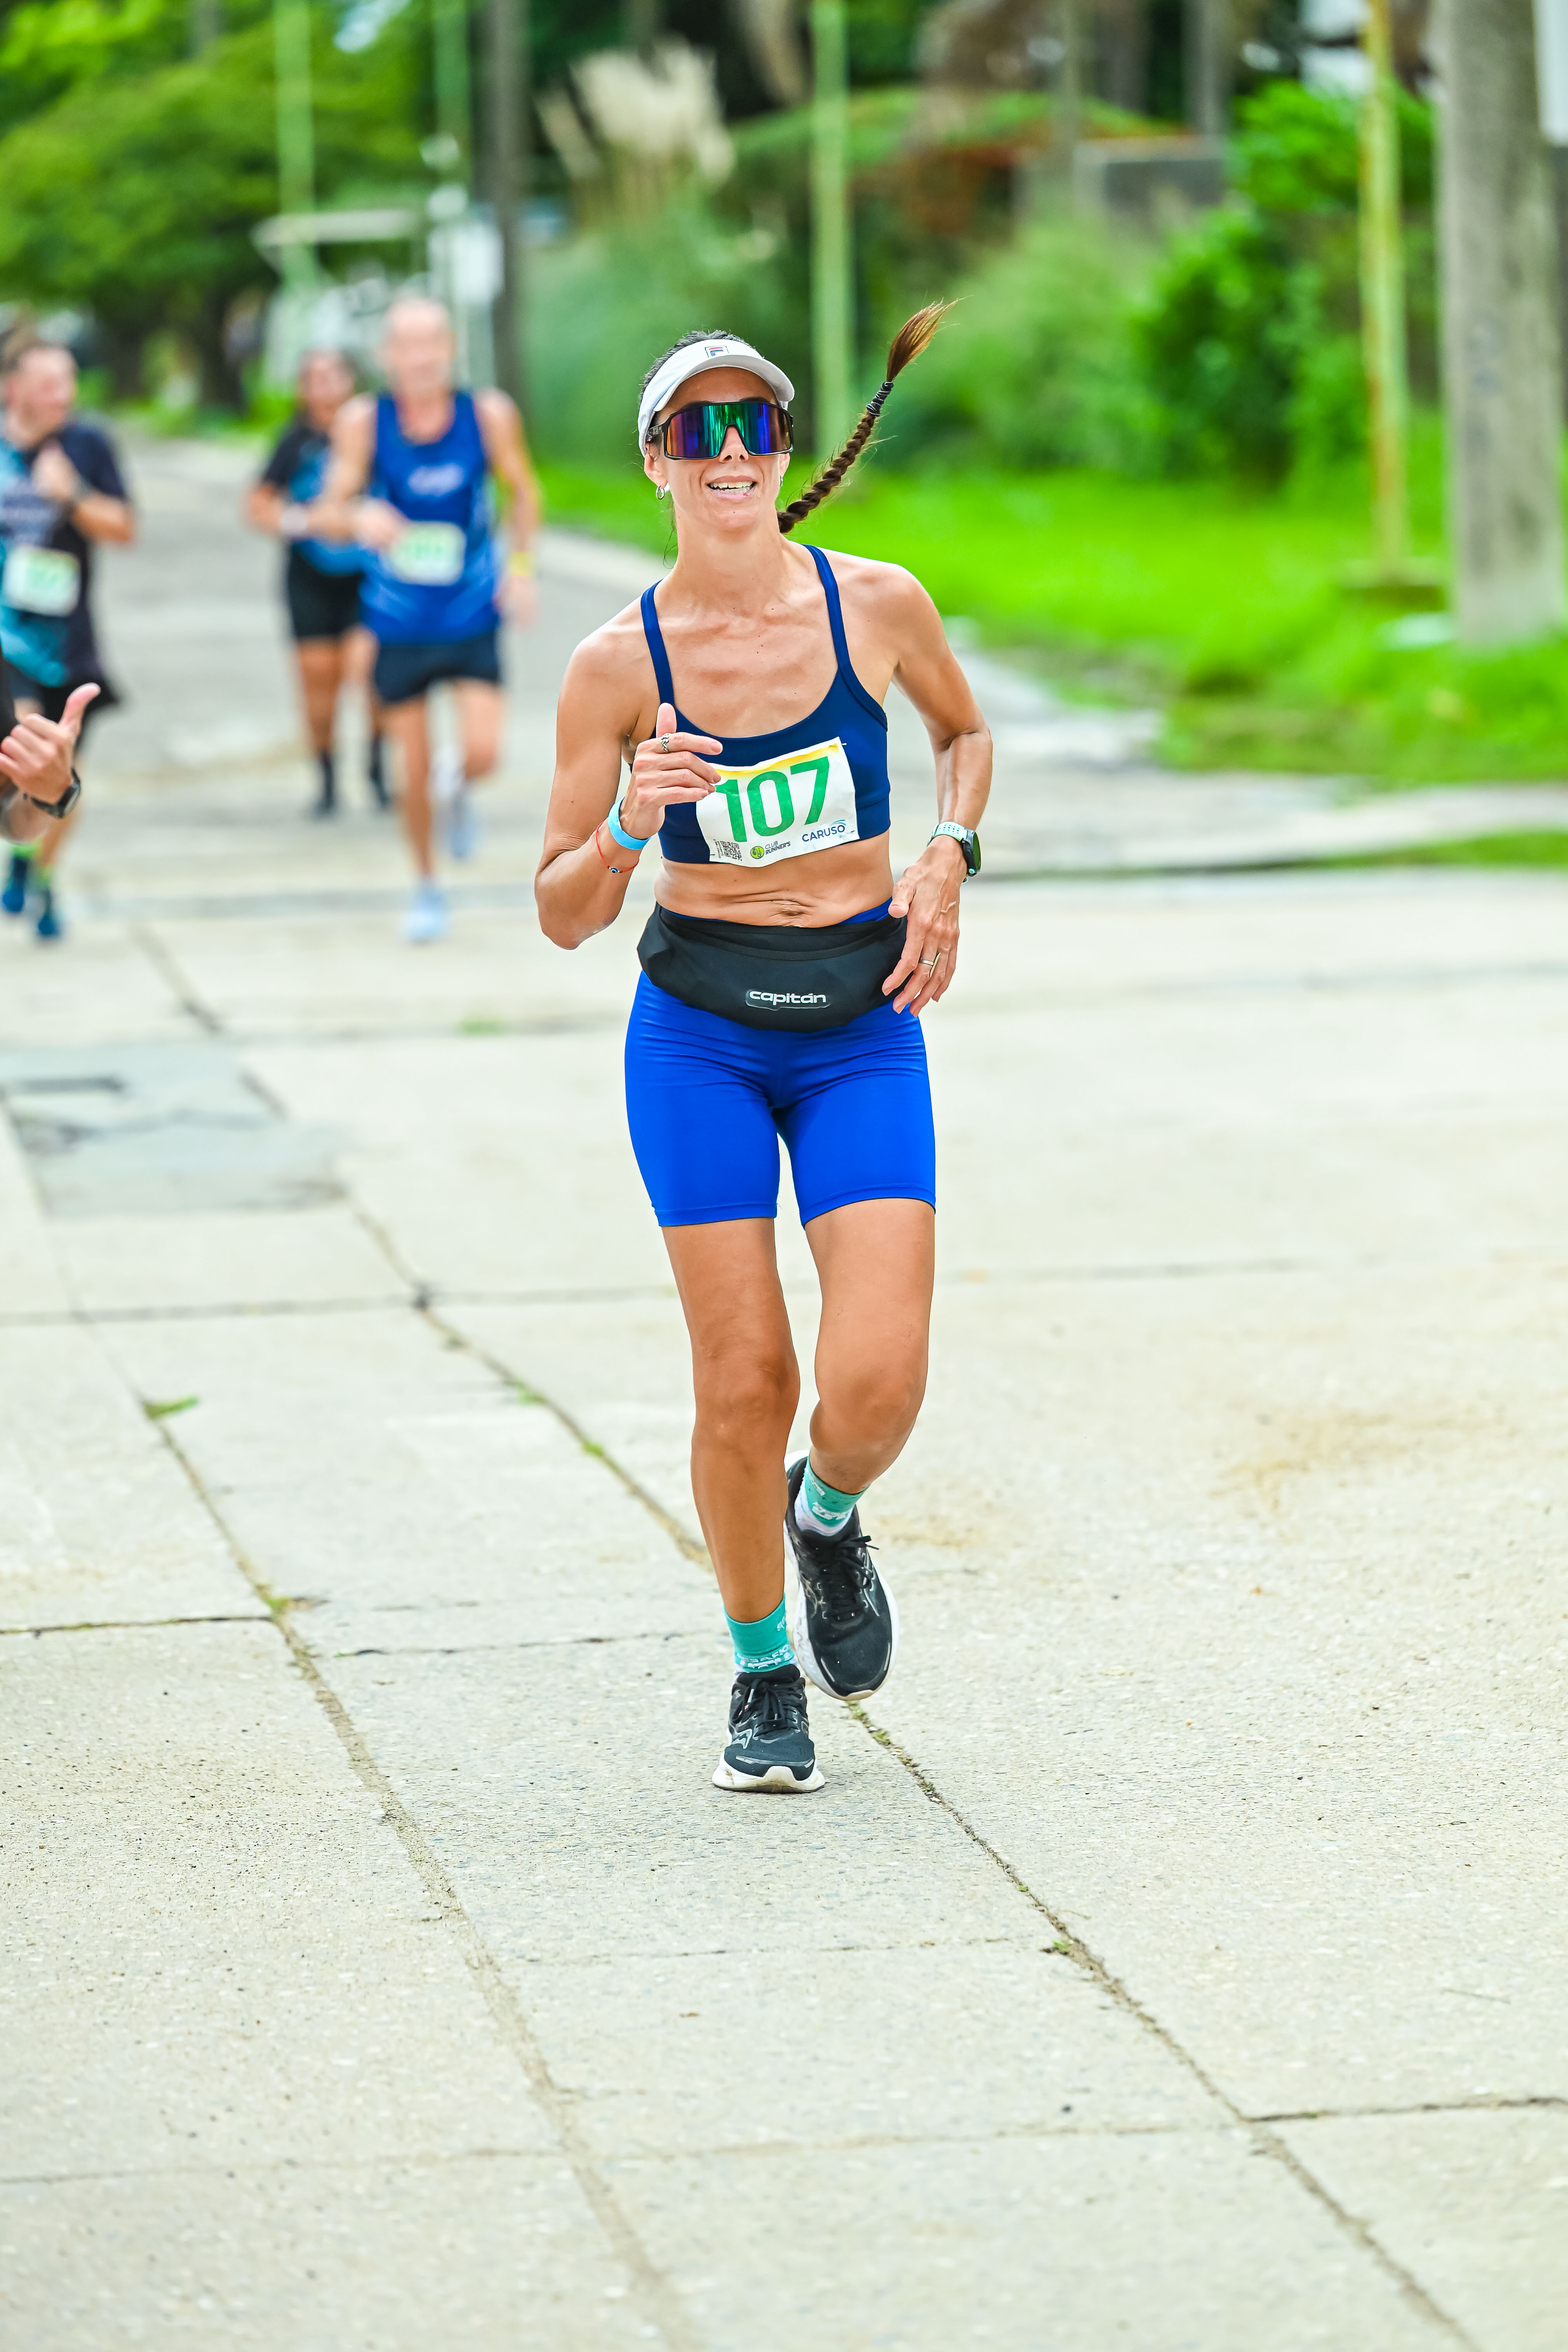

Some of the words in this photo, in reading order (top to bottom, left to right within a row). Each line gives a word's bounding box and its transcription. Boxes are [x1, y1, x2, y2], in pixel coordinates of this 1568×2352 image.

[715, 756, 830, 842] 107
[802, 825, 845, 842] CARUSO
[765, 841, 778, 849] CLUB
[749, 991, 826, 1006] capitán
